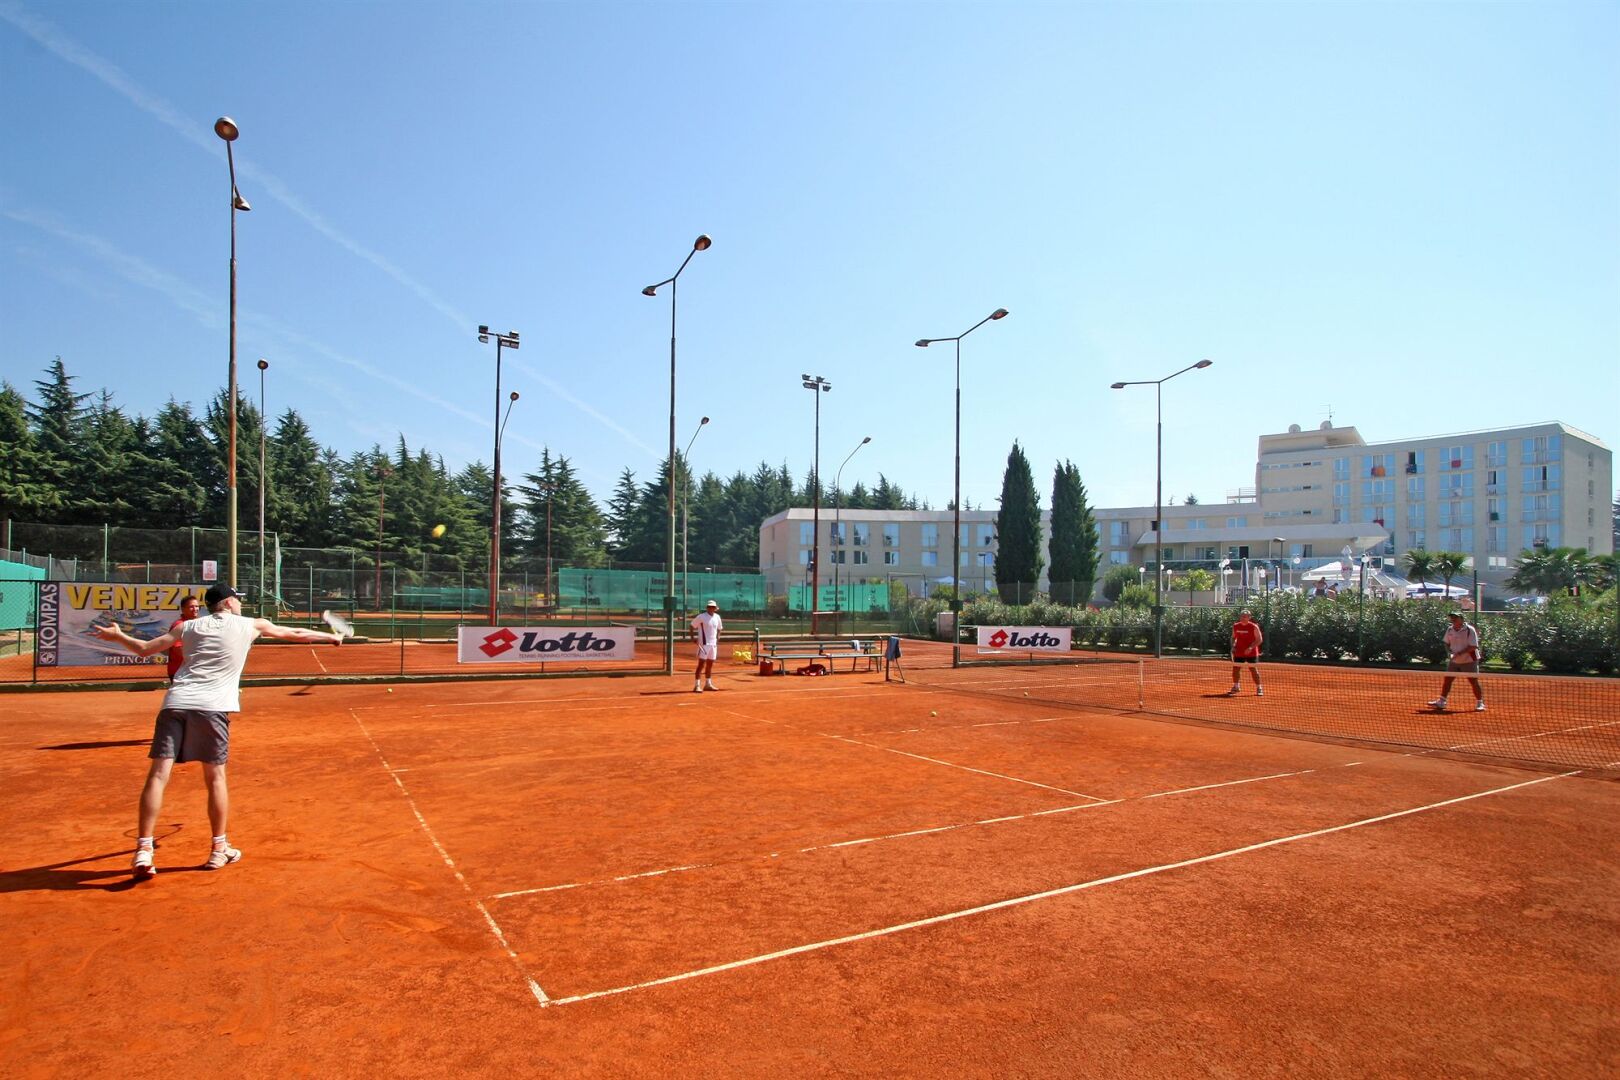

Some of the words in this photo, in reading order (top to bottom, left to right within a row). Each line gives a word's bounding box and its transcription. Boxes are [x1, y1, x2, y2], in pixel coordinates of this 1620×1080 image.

[40, 584, 57, 648] KOMPAS
[519, 632, 616, 653] lotto
[1009, 632, 1060, 647] lotto
[104, 656, 150, 664] PRINCE
